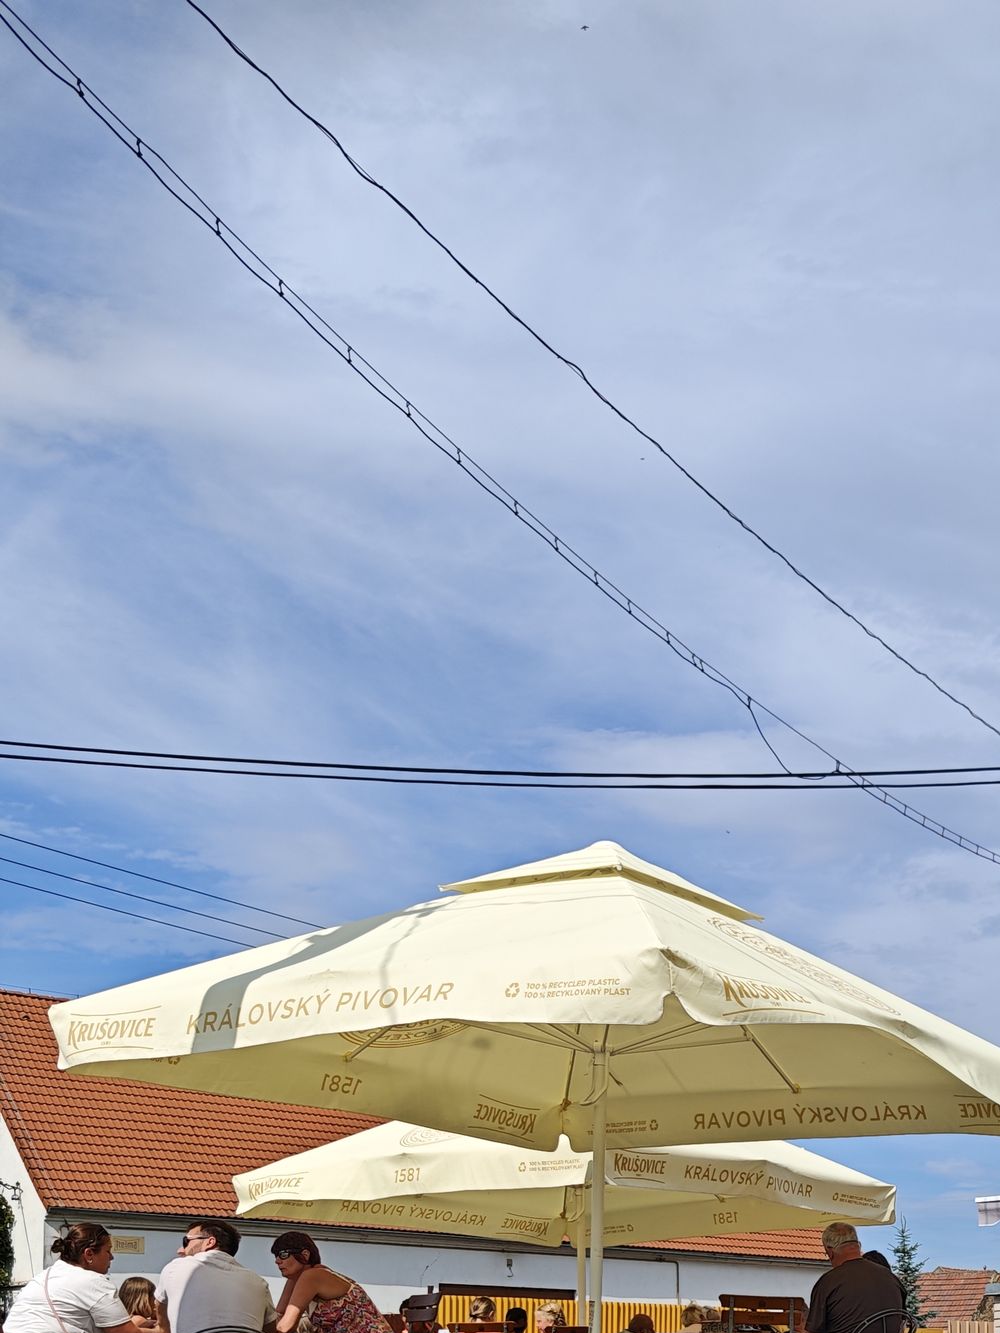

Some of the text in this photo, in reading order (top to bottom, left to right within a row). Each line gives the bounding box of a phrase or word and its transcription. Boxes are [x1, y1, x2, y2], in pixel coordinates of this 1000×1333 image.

[548, 980, 586, 989] RECYCLED
[588, 978, 620, 986] PLASTIC
[603, 988, 632, 996] PLAST
[186, 982, 455, 1035] KRÁLOVSKÝ PIVOVAR
[67, 1017, 157, 1050] KRUŠOVICE
[394, 1167, 421, 1184] 1581
[614, 1153, 666, 1176] KRUŠOVICE
[684, 1163, 813, 1198] KRÁLOVSKÝ PIVOVAR
